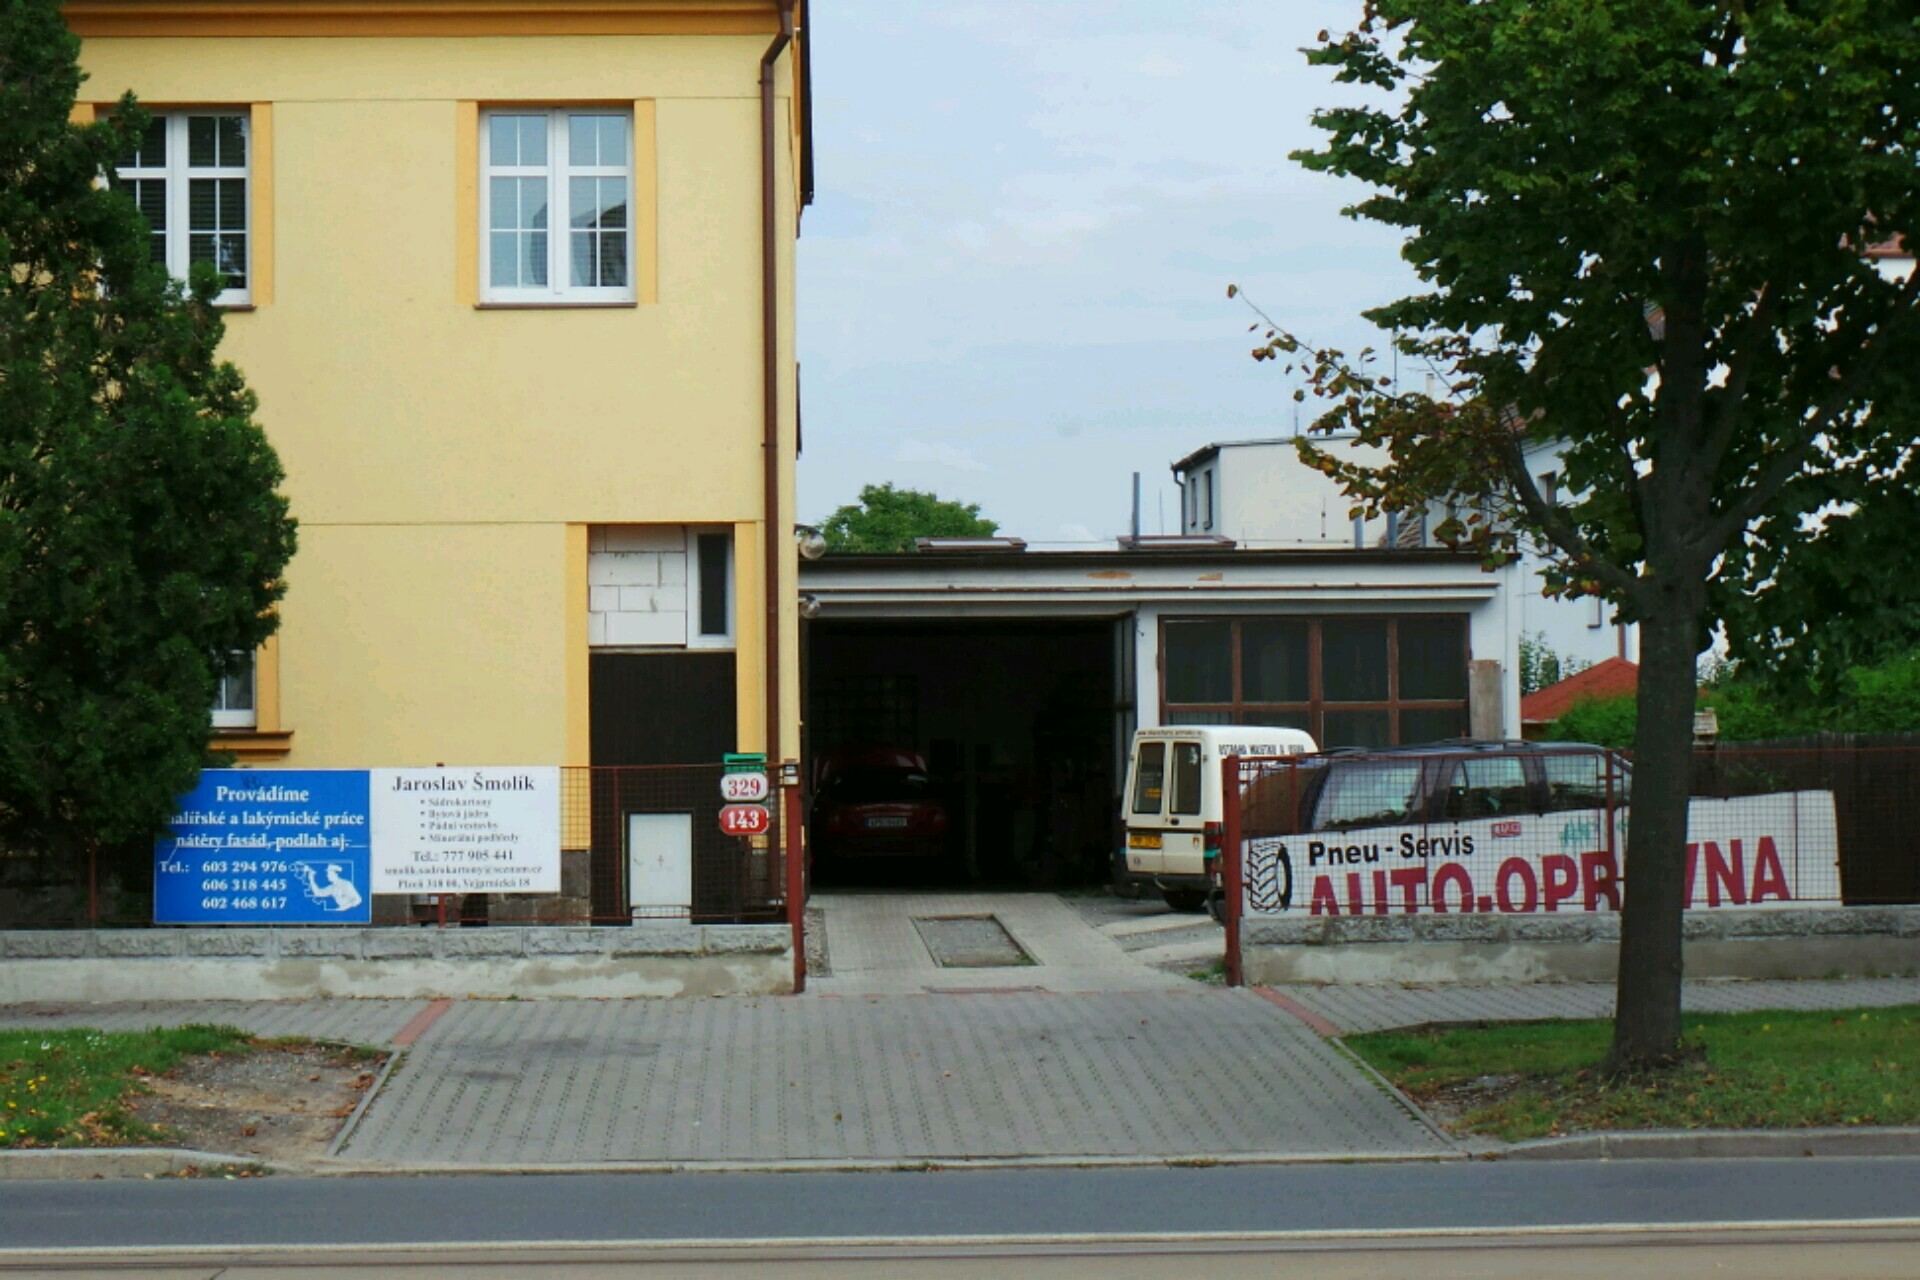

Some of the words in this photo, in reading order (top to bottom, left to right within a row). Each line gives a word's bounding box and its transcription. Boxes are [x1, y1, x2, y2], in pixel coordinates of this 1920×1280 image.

[392, 775, 466, 792] Jaroslav
[472, 772, 535, 792] Šmolík
[728, 778, 760, 796] 329
[216, 785, 310, 802] Provádíme
[171, 811, 225, 825] alířské
[229, 814, 239, 825] a
[242, 811, 320, 829] lakýrnické
[324, 811, 364, 829] práce
[728, 810, 759, 829] 143
[176, 833, 223, 852] nátěry
[276, 833, 327, 852] podlah
[1308, 840, 1379, 867] Pneu
[1399, 829, 1475, 859] Servis
[442, 851, 464, 862] 777
[468, 851, 488, 861] 905
[493, 850, 513, 860] 441
[160, 861, 190, 873] Tel.:
[202, 861, 228, 873] 603
[231, 861, 257, 873] 294
[261, 861, 287, 873] 976
[202, 879, 228, 891] 606
[231, 879, 257, 891] 318
[260, 879, 287, 891] 445
[202, 897, 228, 909] 602
[231, 897, 257, 909] 468
[261, 897, 287, 909] 617
